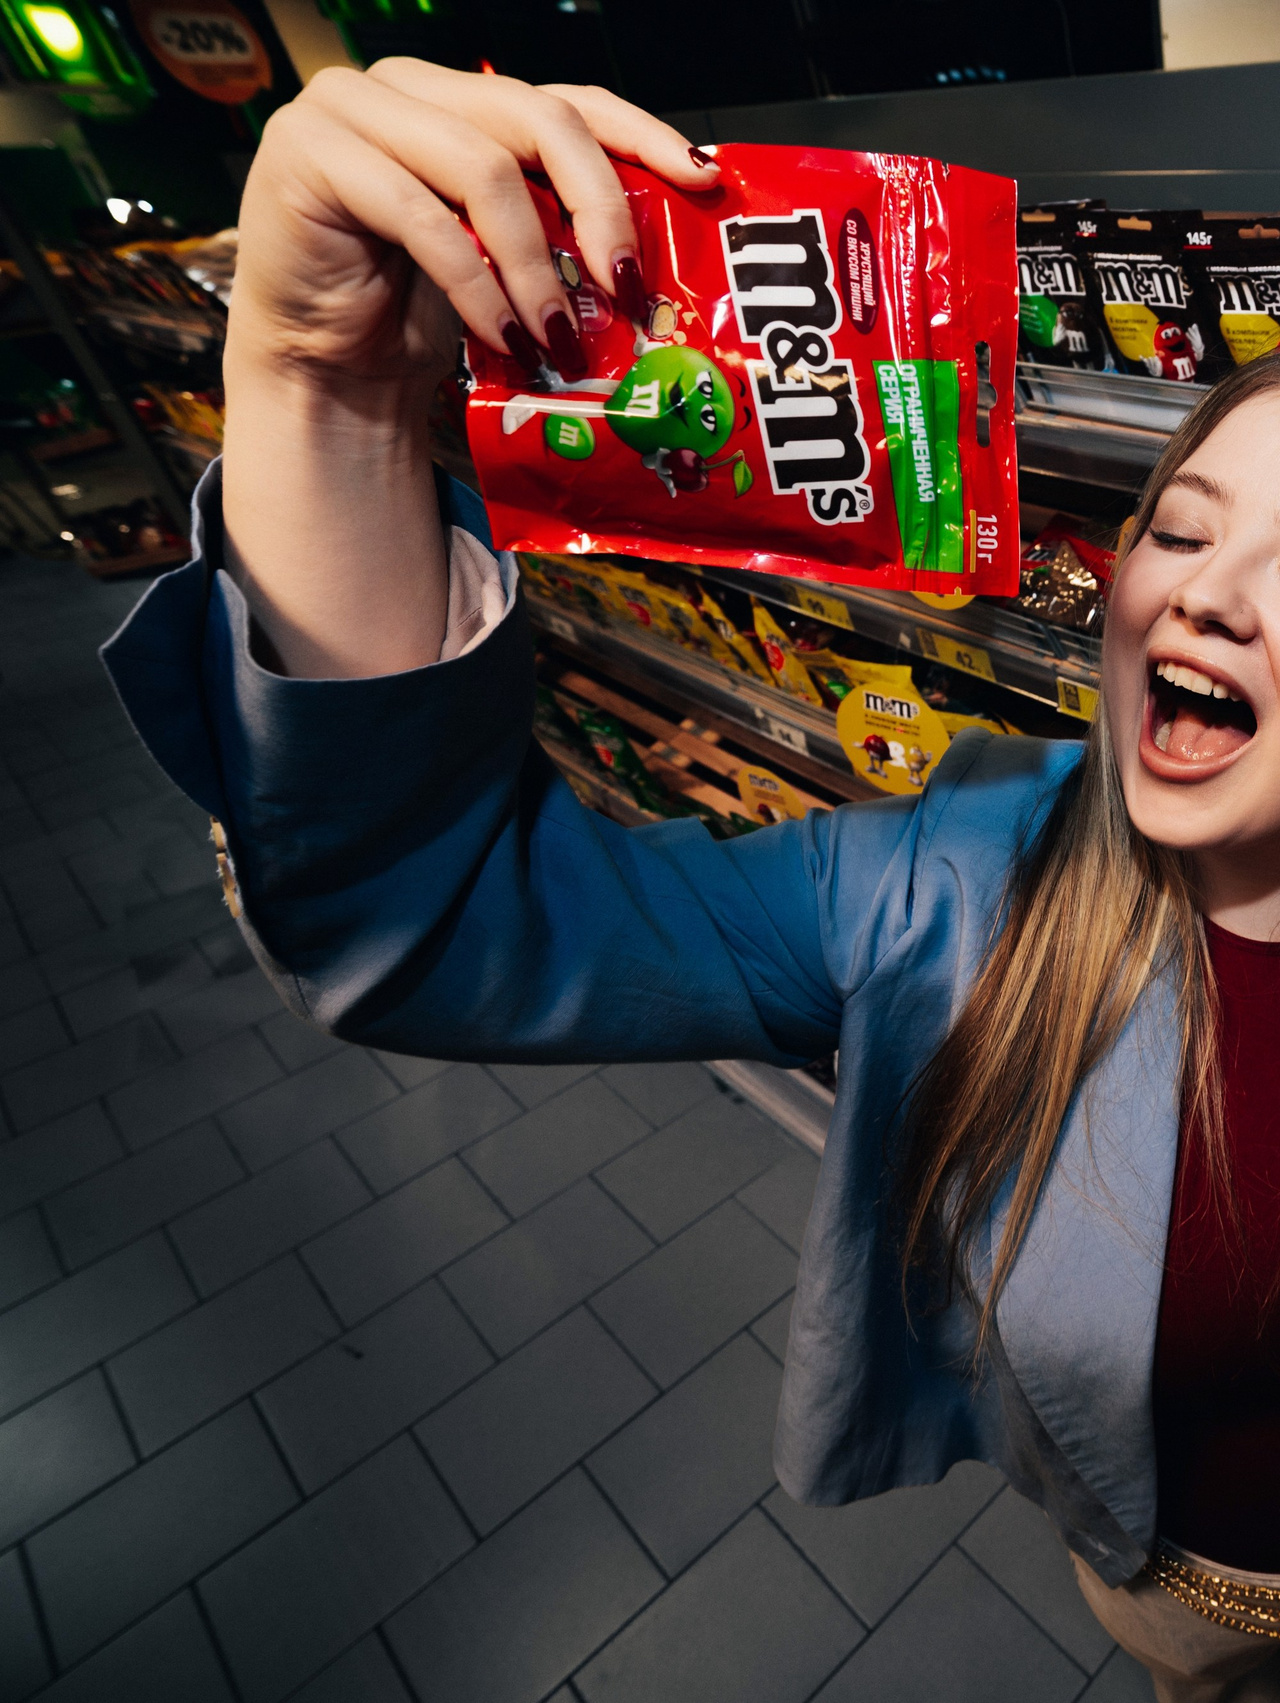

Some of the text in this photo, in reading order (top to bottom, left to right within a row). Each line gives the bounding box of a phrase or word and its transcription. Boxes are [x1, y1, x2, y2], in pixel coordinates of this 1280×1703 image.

[1186, 232, 1213, 246] 145г
[846, 219, 863, 321] СО ВКУСОМ ВИШНИ
[860, 240, 876, 306] ХРУСТЯЩИЙ
[577, 294, 598, 318] m
[719, 208, 874, 525] m&m's
[1172, 356, 1196, 381] m
[625, 380, 661, 418] m
[878, 364, 904, 424] СЕРИЯ
[559, 421, 580, 447] m
[899, 363, 935, 503] ОГРАНИЧЕННАЯ
